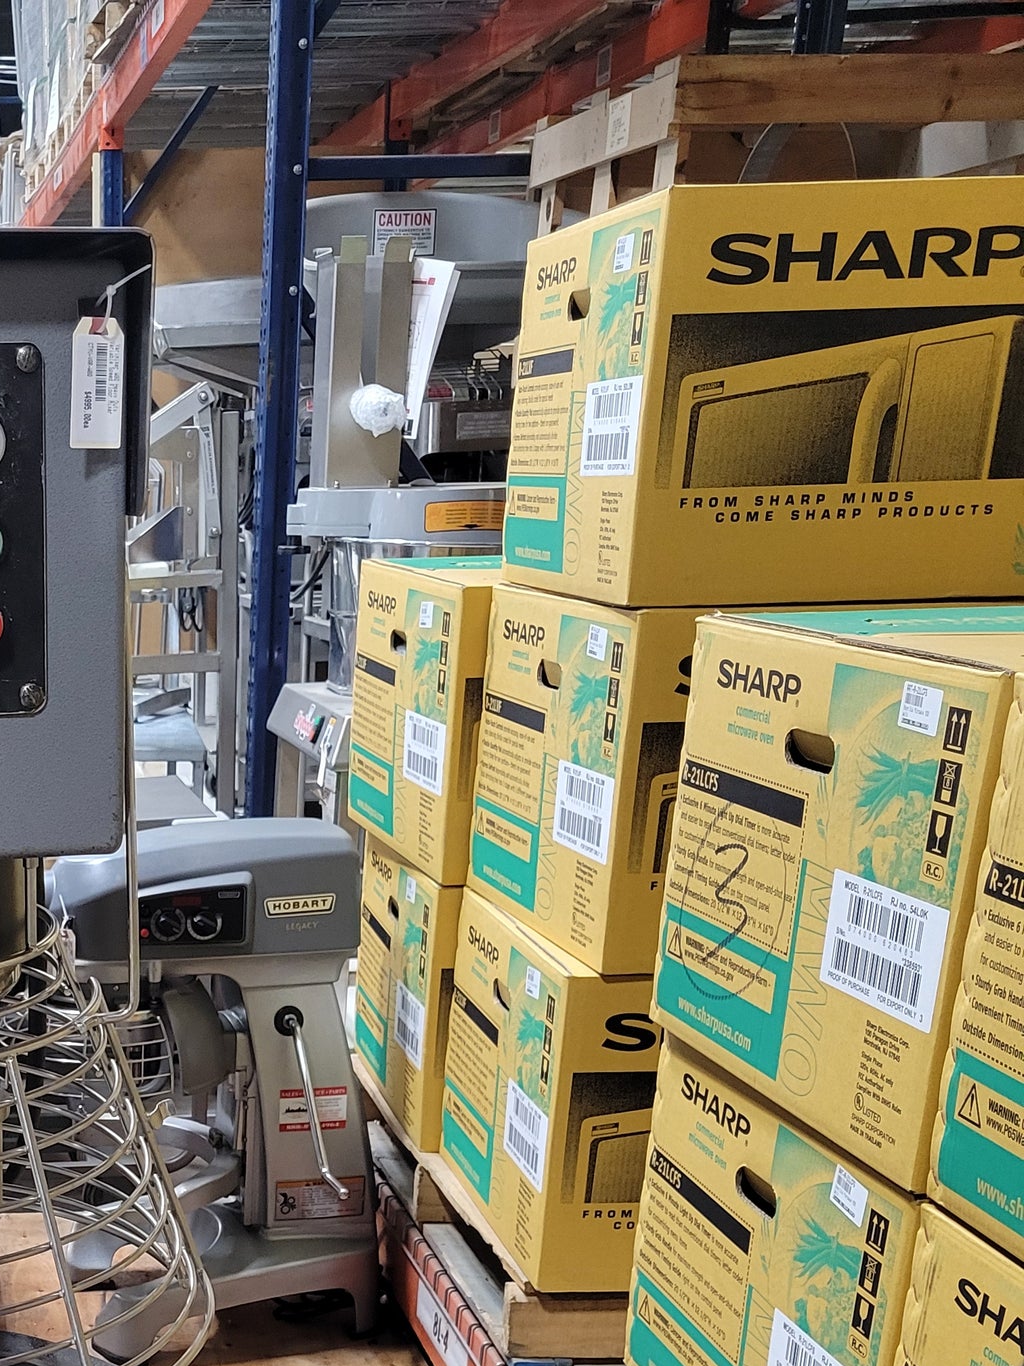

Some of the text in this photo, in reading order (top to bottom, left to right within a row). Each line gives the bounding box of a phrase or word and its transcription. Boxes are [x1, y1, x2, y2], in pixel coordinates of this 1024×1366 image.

[378, 213, 432, 226] CAUTION
[707, 225, 1024, 287] SHARP
[537, 257, 577, 291] SHARP
[680, 491, 914, 508] FROM SHARP MINDS
[716, 504, 993, 523] COME SHARP PRODUCTS
[368, 590, 396, 614] SHARP
[503, 619, 545, 647] SHARP
[717, 659, 801, 703] SHARP
[736, 706, 771, 724] commercial
[727, 722, 774, 745] microwave oven
[682, 764, 719, 791] R-21LCFS
[735, 814, 743, 825] Dial
[744, 818, 756, 830] Timer
[371, 851, 392, 882] SHARP
[926, 866, 940, 878] R.C.
[844, 880, 860, 894] MODEL
[890, 896, 897, 907] RJ
[899, 902, 908, 911] no.
[990, 869, 1024, 905] R-21L
[272, 899, 328, 911] HOBART
[286, 921, 320, 931] LEGACY
[987, 909, 1014, 931] Exclusive
[468, 925, 499, 965] SHARP
[984, 931, 1021, 955] and easier to
[980, 952, 1024, 985] for customizing
[828, 970, 841, 984] PROOF
[842, 977, 847, 986] OF
[848, 980, 870, 997] PURCHASE
[877, 994, 886, 1005] FOR
[886, 998, 904, 1013] EXPORT
[904, 1006, 916, 1019] ONLY
[975, 975, 1006, 1000] Sturdy Grab
[971, 997, 1004, 1023] Convenient
[678, 996, 751, 1051] www.sharpusa.com
[866, 1020, 877, 1032] Sharp
[878, 1023, 898, 1042] Electronics
[962, 1018, 986, 1040] Outside
[681, 1073, 751, 1138] SHARP
[862, 1106, 881, 1123] LISTED
[988, 1098, 1019, 1126] WARNING:
[696, 1121, 725, 1150] commercial
[849, 1124, 882, 1148] MADE THAILAND
[865, 1121, 896, 1146] CORPORATION
[689, 1133, 726, 1170] microwave oven
[652, 1151, 682, 1189] R-21LCFS
[582, 1210, 633, 1219] FROM
[613, 1221, 636, 1230] CO
[954, 1278, 1024, 1355] SHA
[783, 1322, 795, 1339] MODEL
[852, 1339, 865, 1356] R.C.
